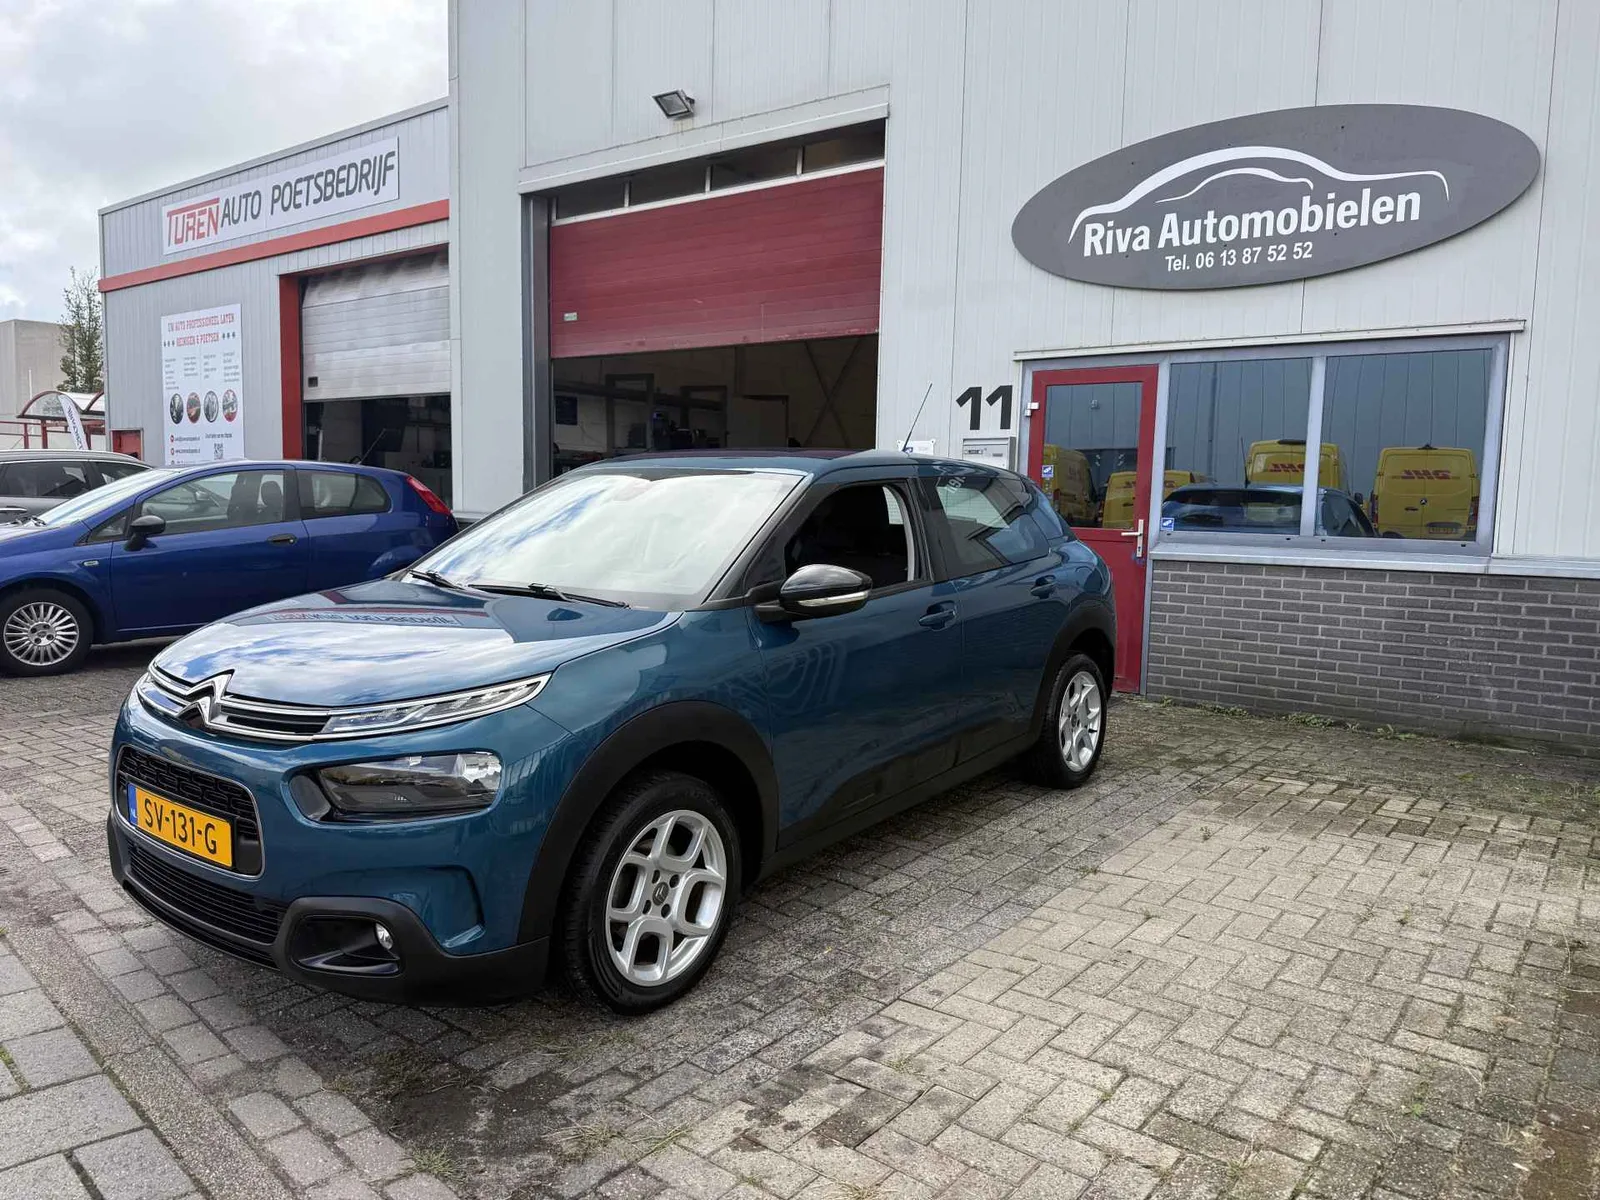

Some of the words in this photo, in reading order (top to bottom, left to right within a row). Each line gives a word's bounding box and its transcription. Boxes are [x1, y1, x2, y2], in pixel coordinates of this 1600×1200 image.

[270, 151, 396, 215] POETSBEDRIJF
[1083, 220, 1151, 257] Riva
[1157, 188, 1422, 249] Automobielen
[1165, 255, 1191, 272] Tel.
[1195, 251, 1215, 269] 06
[1219, 248, 1238, 266] 13
[1242, 246, 1262, 264] 87
[1267, 244, 1288, 262] 52
[1293, 241, 1314, 259] 52
[956, 385, 1013, 431] 11
[144, 798, 218, 855] SV-131-G
